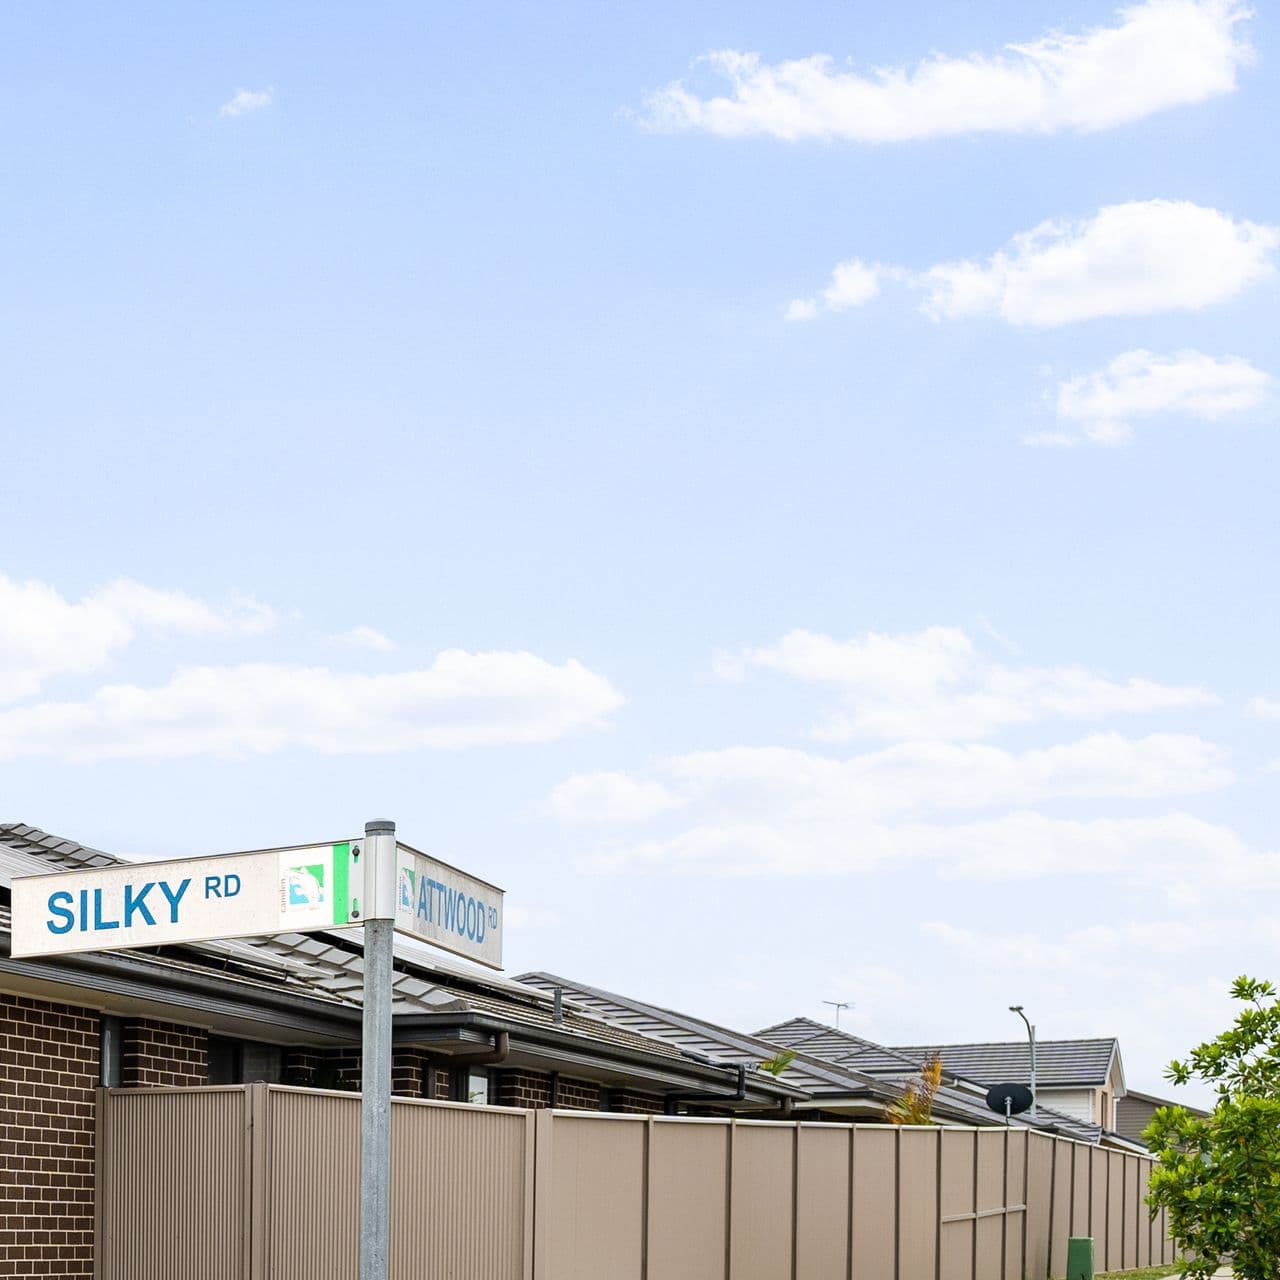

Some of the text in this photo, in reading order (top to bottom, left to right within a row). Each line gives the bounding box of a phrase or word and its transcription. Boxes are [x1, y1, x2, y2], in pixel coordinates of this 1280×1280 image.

[46, 874, 241, 935] SILKY RD
[417, 875, 498, 944] ATTWOOD RD
